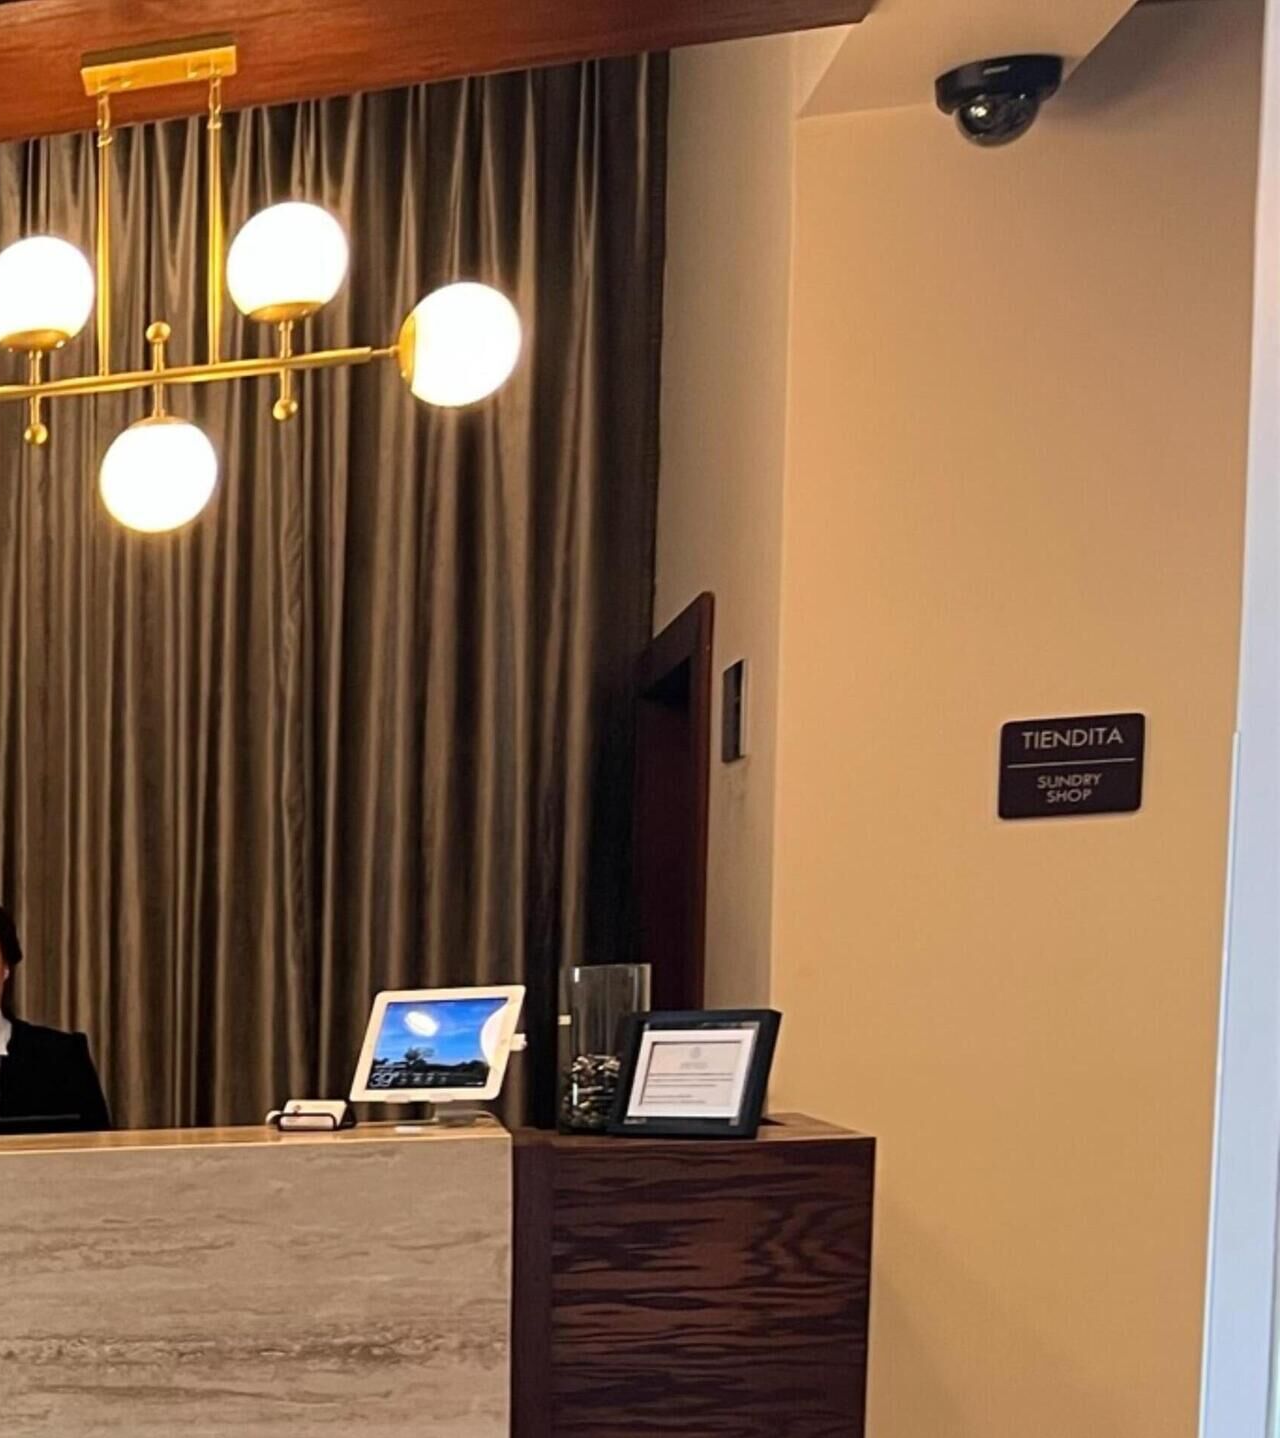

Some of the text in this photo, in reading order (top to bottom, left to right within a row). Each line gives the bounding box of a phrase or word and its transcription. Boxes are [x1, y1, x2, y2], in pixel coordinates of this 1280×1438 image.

[1022, 727, 1124, 750] TIENDITA
[1037, 773, 1103, 789] SUNDRY
[1046, 789, 1093, 804] SHOP
